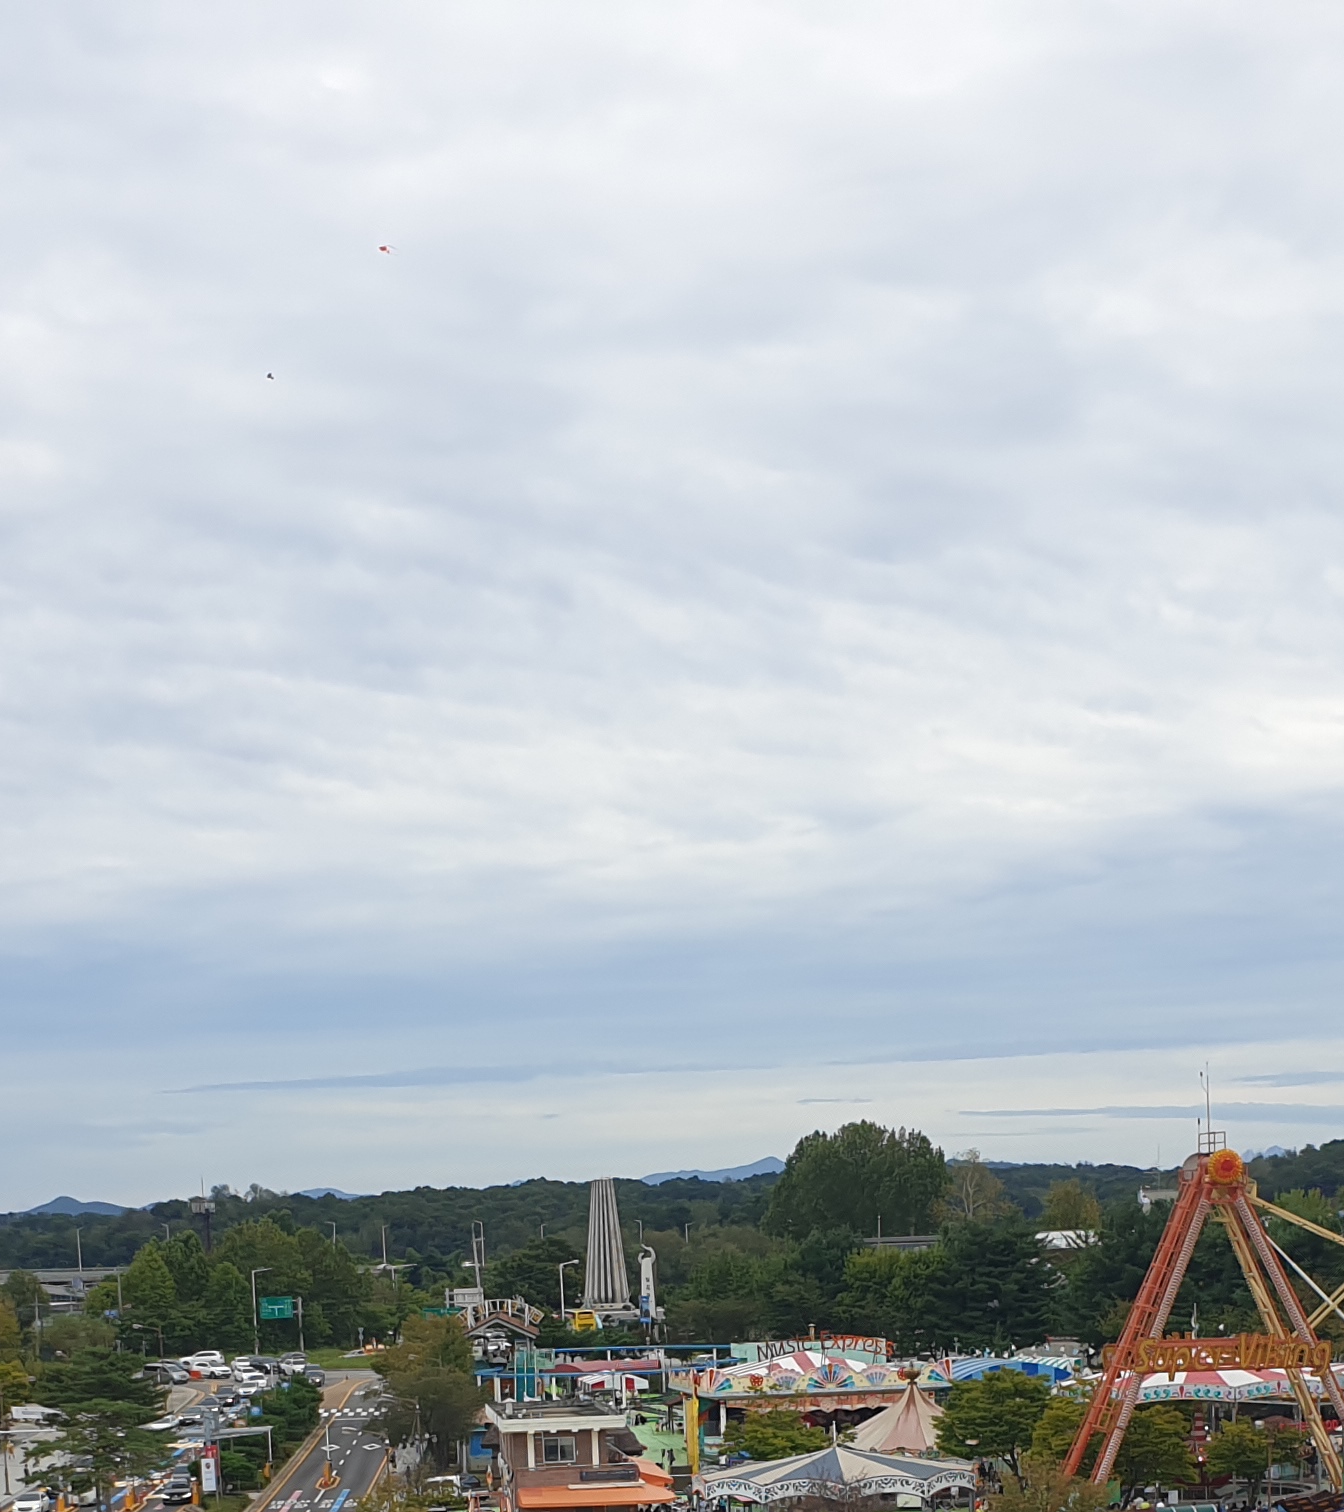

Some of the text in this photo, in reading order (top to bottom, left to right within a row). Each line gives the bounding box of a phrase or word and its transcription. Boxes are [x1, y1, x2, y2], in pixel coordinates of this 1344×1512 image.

[757, 1331, 895, 1362] Music Express
[1135, 1333, 1331, 1381] Super Viking
